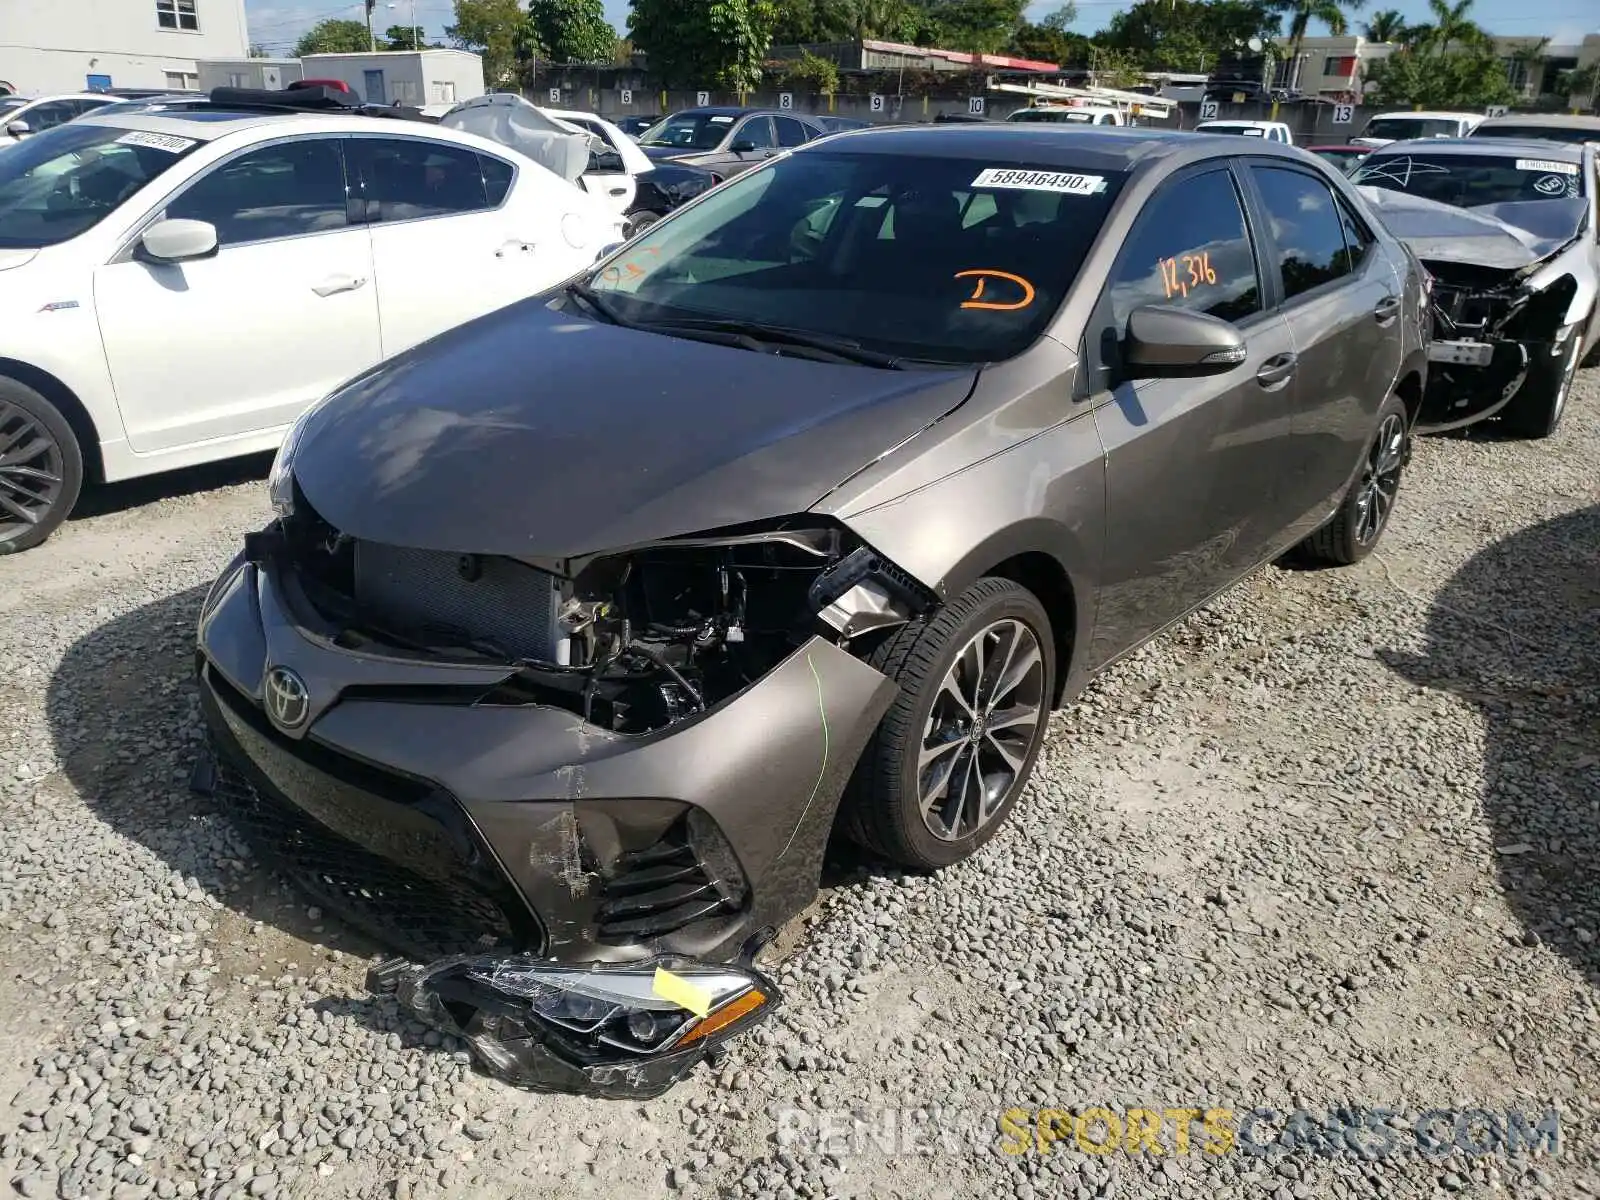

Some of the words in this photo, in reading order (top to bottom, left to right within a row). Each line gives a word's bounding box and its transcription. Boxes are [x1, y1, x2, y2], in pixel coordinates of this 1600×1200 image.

[552, 90, 558, 100] 5
[623, 92, 630, 102] 6
[699, 94, 707, 104] 7
[782, 96, 789, 107] 8
[873, 97, 881, 110] 9
[970, 99, 982, 112] 10
[1202, 104, 1217, 118] 12
[1335, 106, 1350, 122] 13
[954, 269, 1035, 310] D
